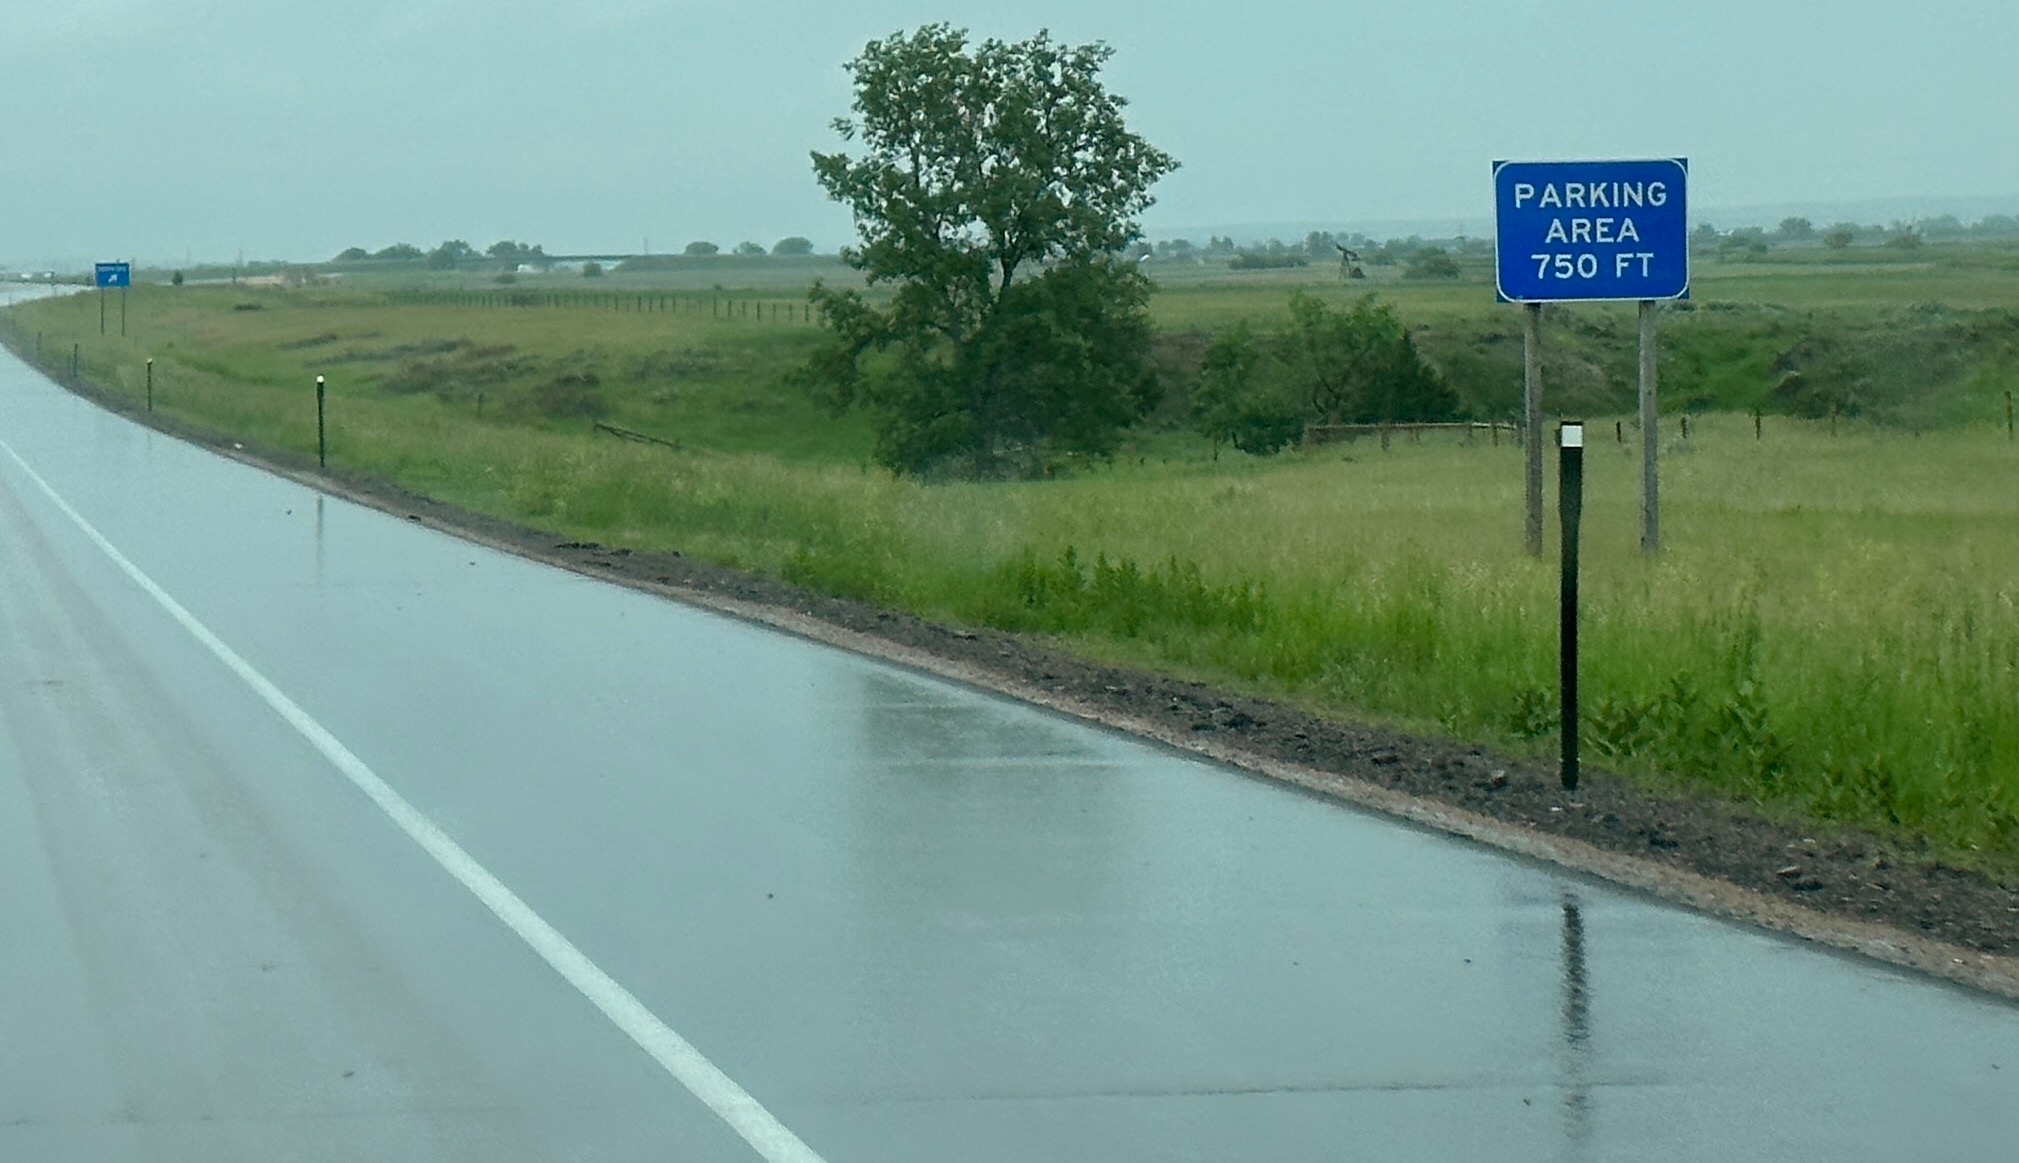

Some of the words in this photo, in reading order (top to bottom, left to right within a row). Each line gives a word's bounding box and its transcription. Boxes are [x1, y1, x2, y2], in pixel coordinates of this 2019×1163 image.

[1515, 182, 1667, 208] PARKING
[1544, 217, 1640, 244] AREA
[1531, 253, 1598, 279] 750
[1616, 252, 1654, 278] FT
